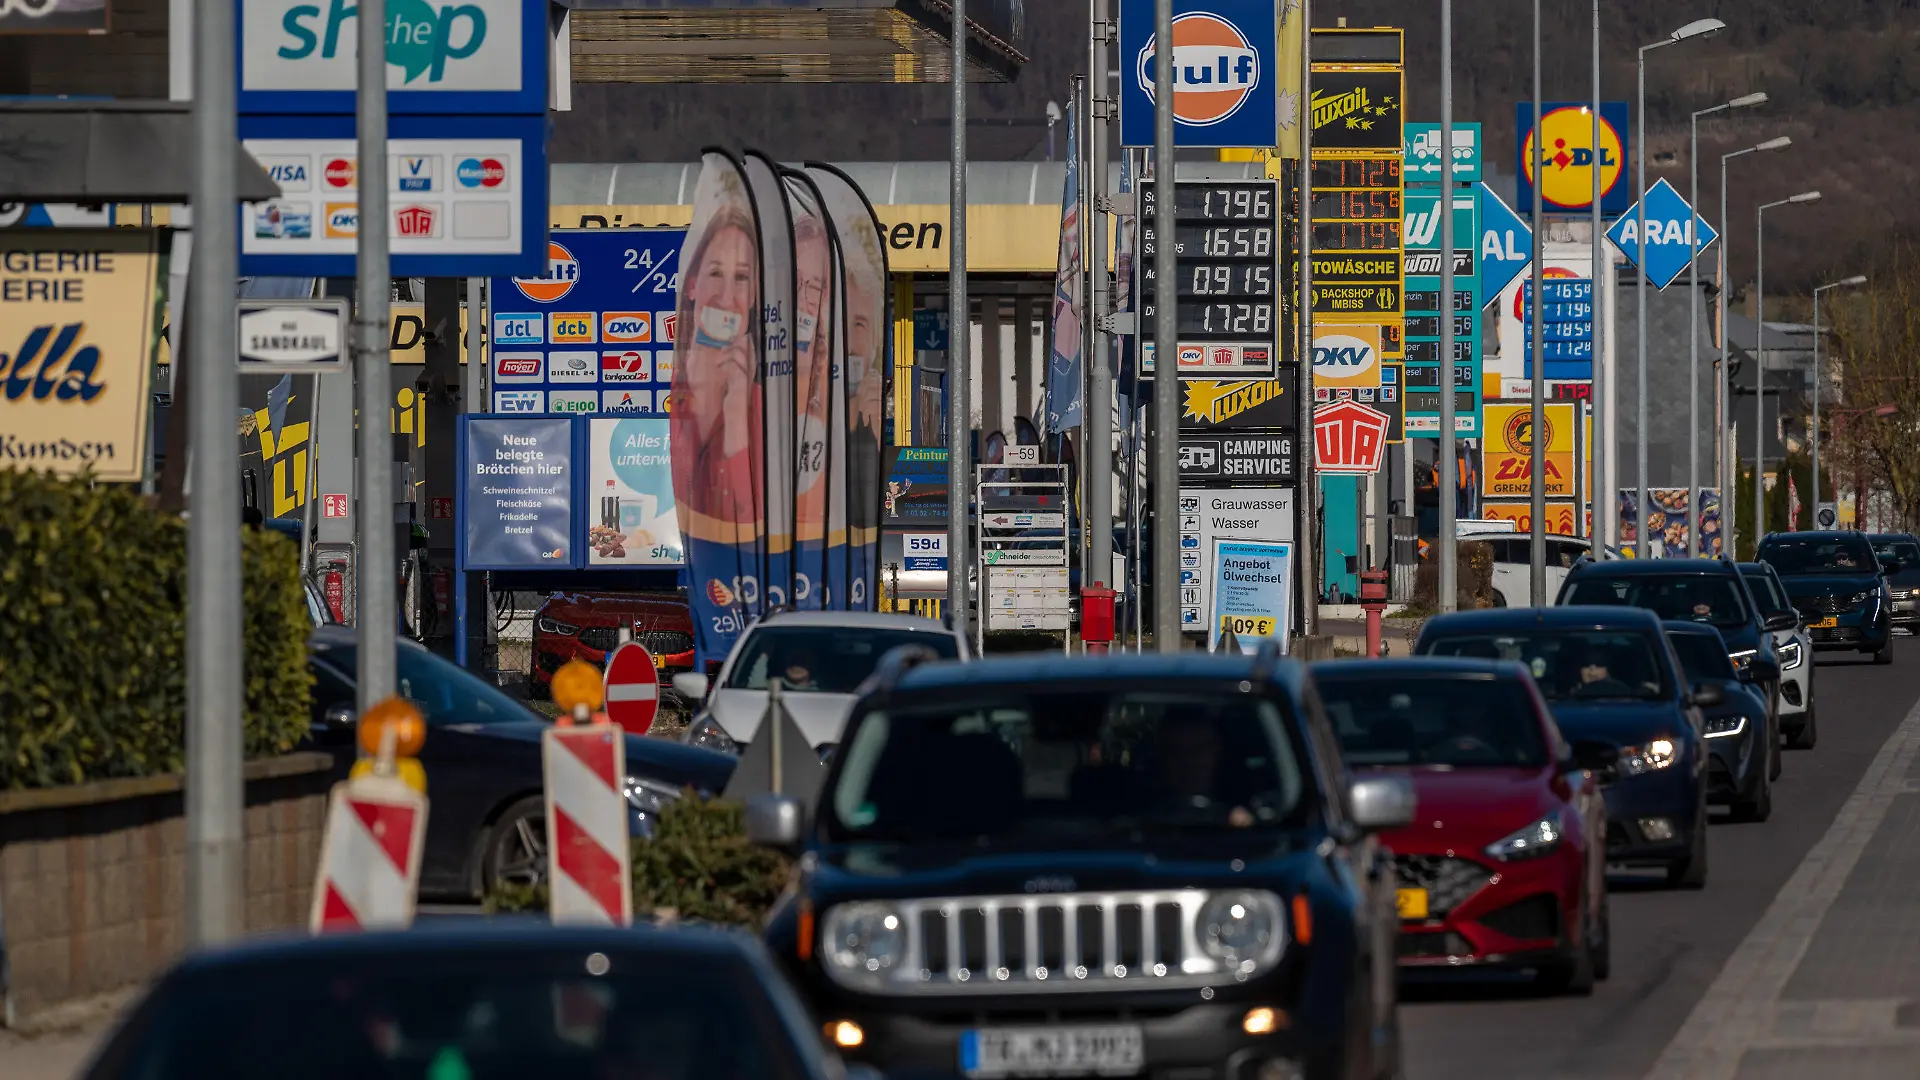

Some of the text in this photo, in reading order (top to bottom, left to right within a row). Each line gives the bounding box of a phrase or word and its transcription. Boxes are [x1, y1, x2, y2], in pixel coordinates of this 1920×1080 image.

[1203, 190, 1271, 218] 1.796
[332, 214, 358, 227] DK
[1203, 228, 1272, 256] 1.658
[1193, 266, 1271, 295] 0.915
[1321, 288, 1375, 299] BACKSHOP
[1331, 299, 1364, 309] IMBISS
[1203, 304, 1271, 333] 1.728
[505, 320, 531, 337] dcl
[557, 320, 588, 336] dcb
[609, 321, 645, 334] DKV
[251, 336, 328, 352] SANDKAUL
[1181, 352, 1201, 360] DKV
[604, 371, 649, 382] tankpool24
[605, 405, 650, 414] ANDAMUR
[503, 434, 537, 446] Neue
[625, 433, 661, 448] Alles
[1019, 448, 1035, 460] 59
[1223, 439, 1291, 456] CAMPING
[495, 448, 544, 463] belegte
[906, 449, 949, 461] Peintur
[476, 462, 563, 476] Brötchen hier
[1223, 458, 1291, 475] SERVICE
[483, 486, 557, 496] Schweineschnitzel
[496, 499, 542, 509] Fleischkäse
[1211, 497, 1288, 512] Grauwasser
[499, 512, 539, 522] Frikadelle
[1212, 517, 1260, 530] Wasser
[504, 525, 533, 535] Bretzel
[910, 538, 940, 550] 59d
[1223, 558, 1271, 571] Angebot
[1223, 568, 1282, 584] Ölwechsel
